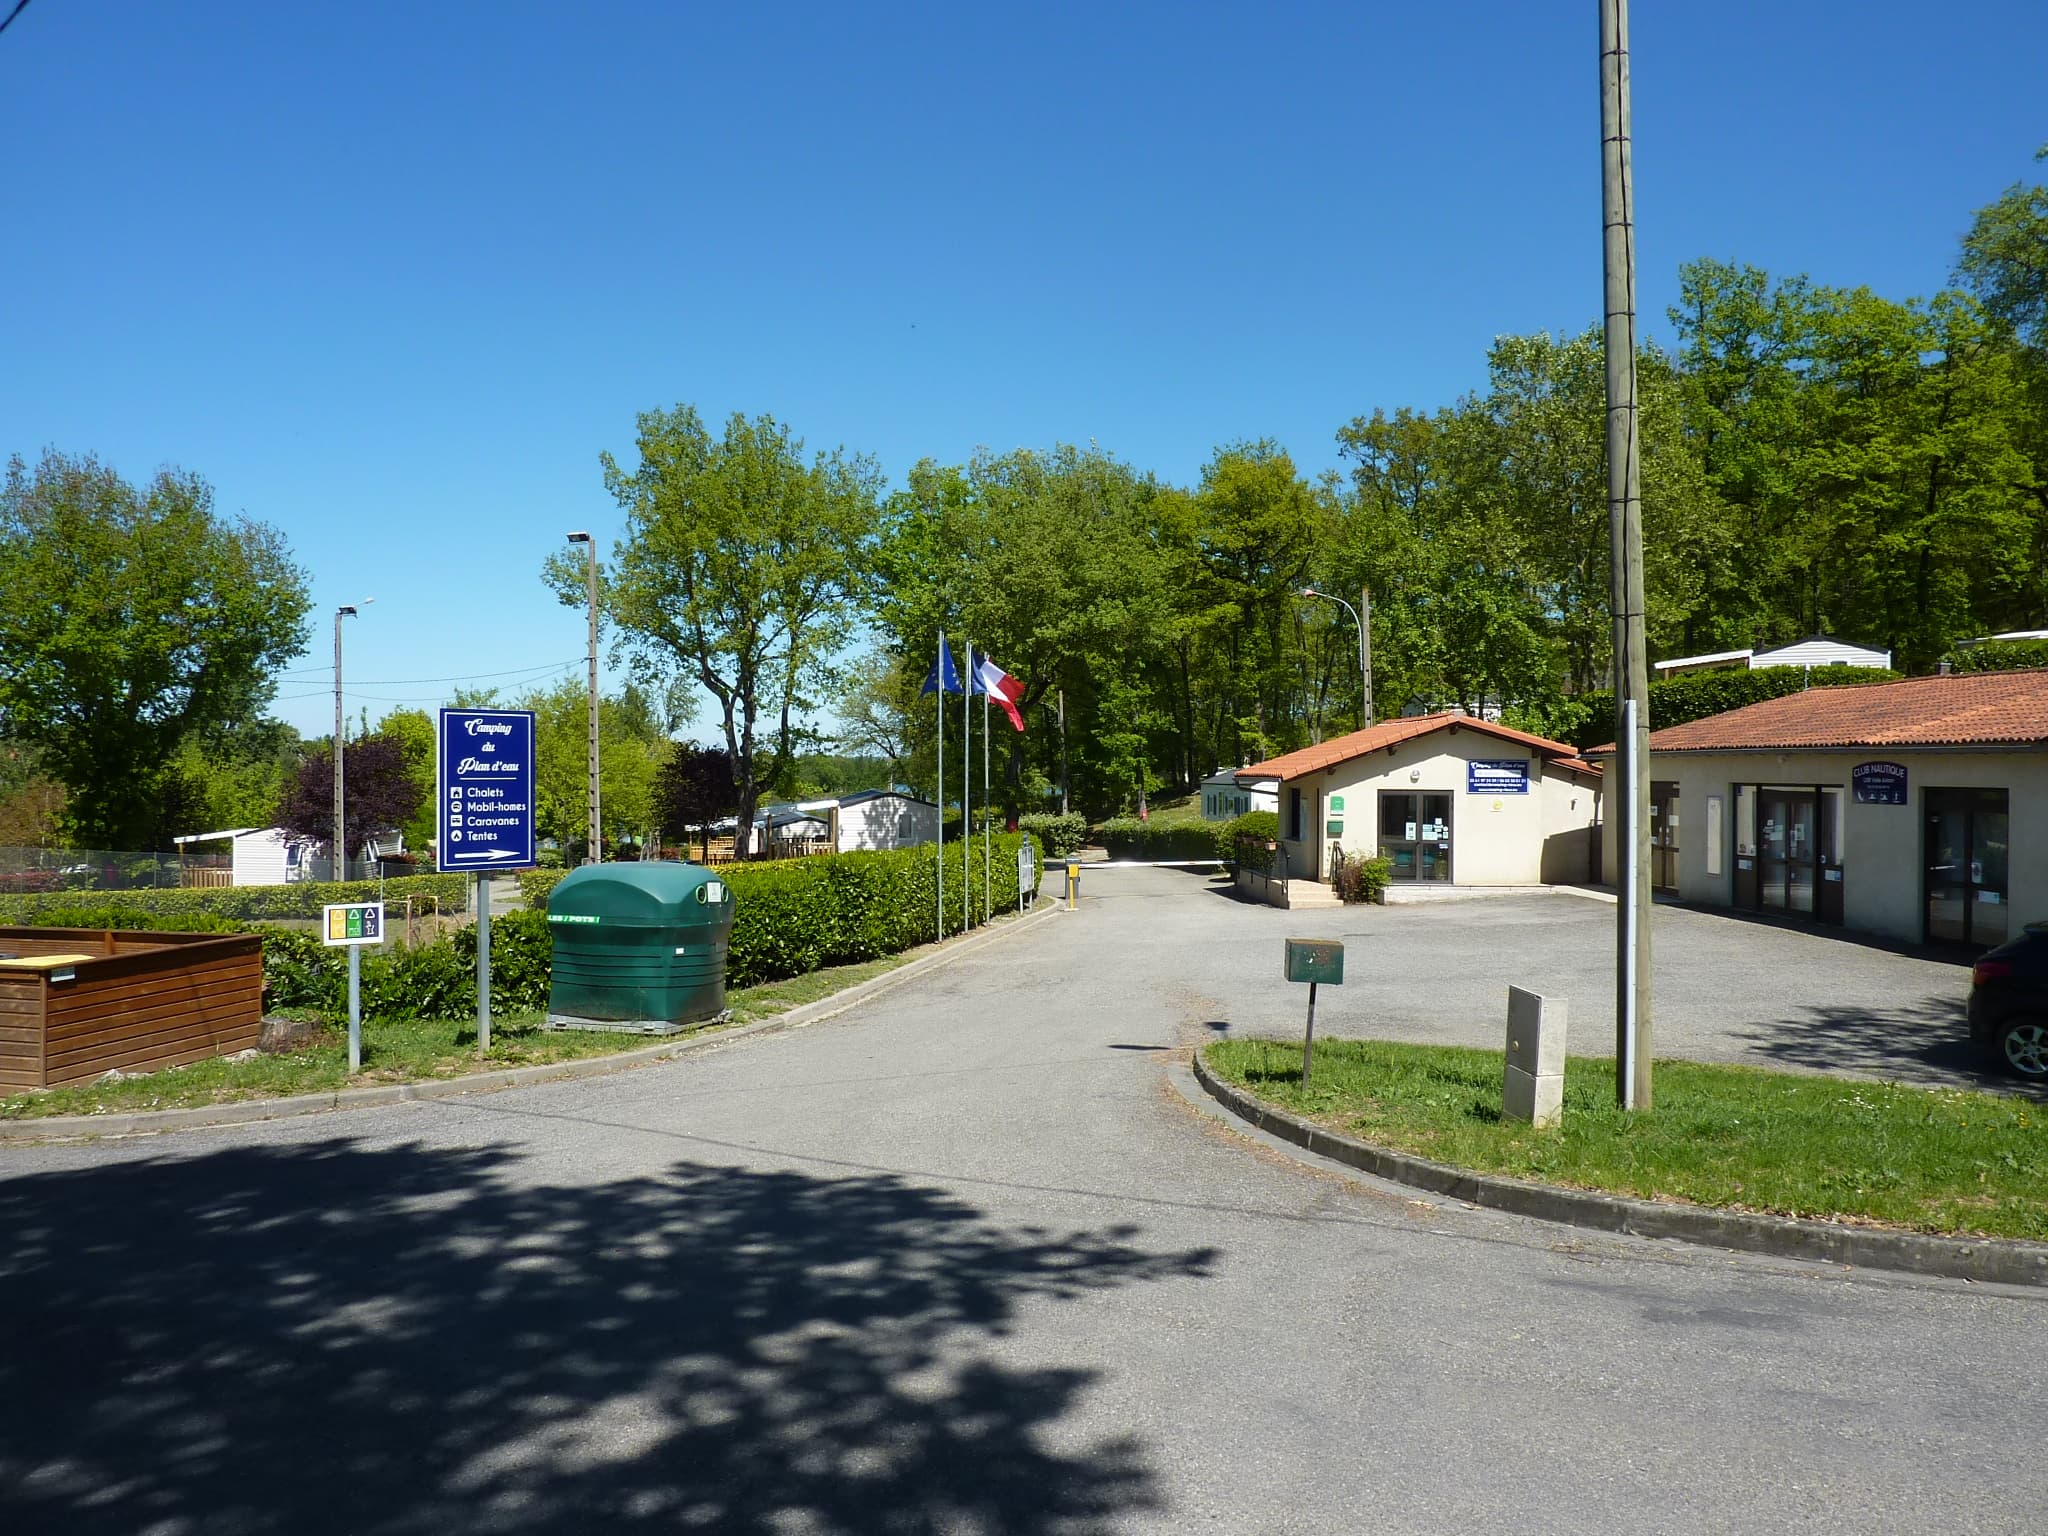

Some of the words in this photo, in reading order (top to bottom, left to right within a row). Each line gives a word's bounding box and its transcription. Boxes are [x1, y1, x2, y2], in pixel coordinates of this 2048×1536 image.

[464, 718, 512, 736] Camping
[481, 742, 496, 752] du
[457, 757, 490, 774] Plan
[491, 761, 519, 772] d'eau
[1853, 764, 1871, 778] CLUB
[1871, 763, 1905, 778] NAUTIQUE
[467, 787, 504, 798] Chalets
[467, 802, 527, 812] Mobil-homes
[467, 816, 519, 826] Caravanes
[467, 831, 498, 841] Tentes
